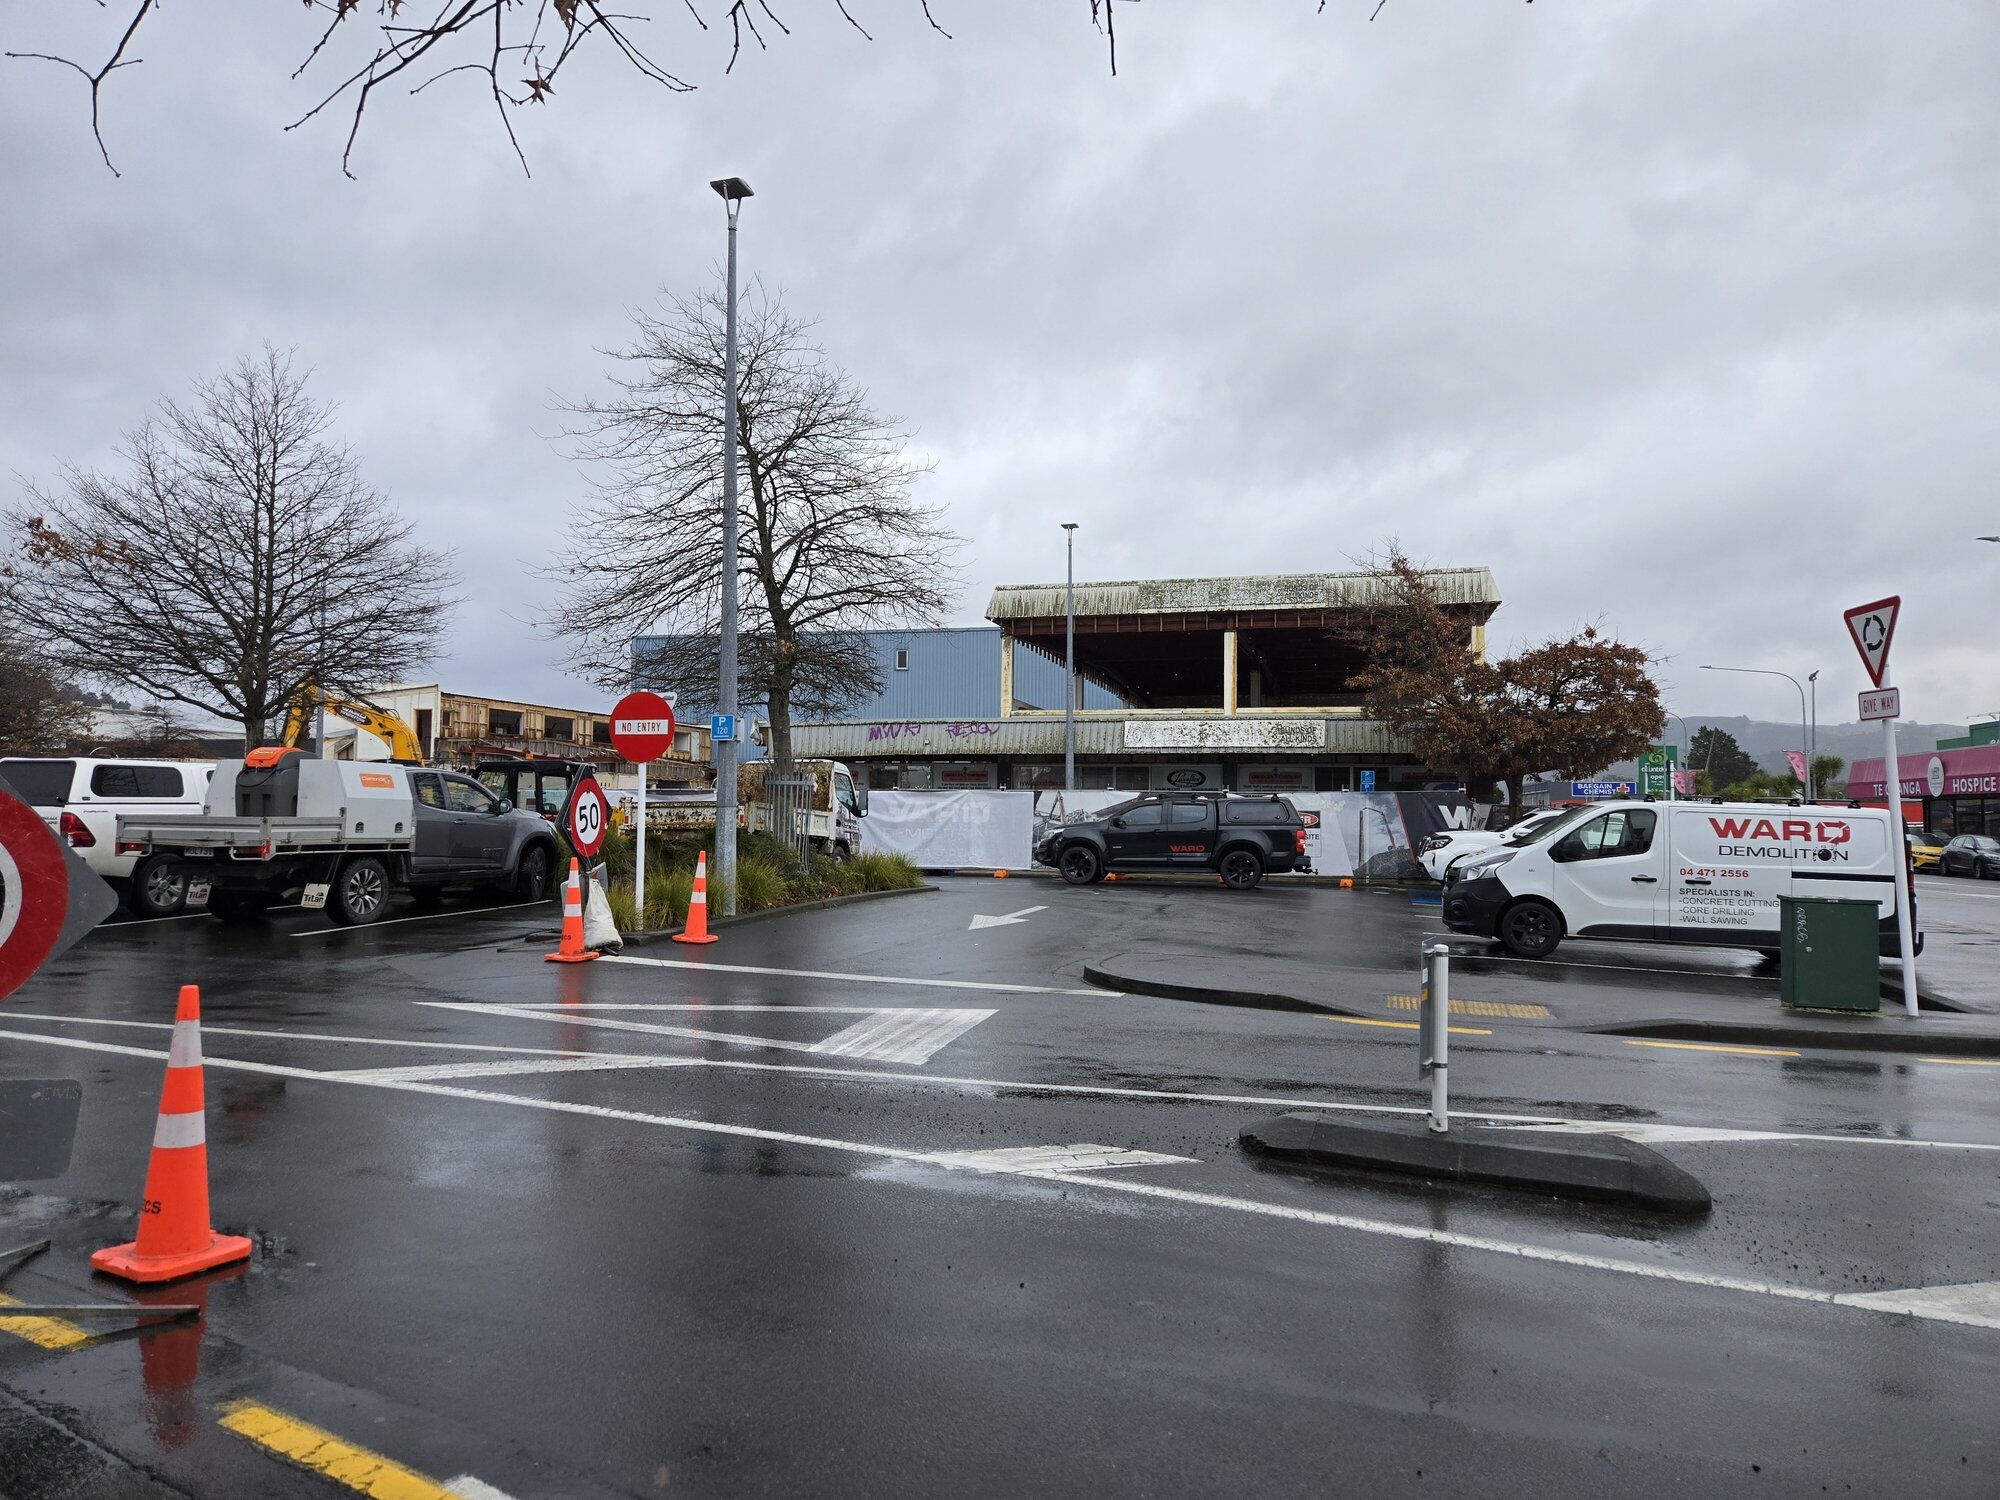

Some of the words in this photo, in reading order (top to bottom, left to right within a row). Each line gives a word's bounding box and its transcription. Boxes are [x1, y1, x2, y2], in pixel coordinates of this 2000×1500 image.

[1863, 699, 1877, 713] GIVE
[1880, 696, 1895, 711] WAY
[718, 716, 726, 726] P
[622, 722, 632, 732] NO
[638, 722, 661, 733] ENTRY
[717, 727, 728, 735] 120
[1952, 776, 1997, 793] HOSPICE
[1874, 784, 1883, 796] TE
[578, 802, 600, 834] 50
[1708, 817, 1851, 846] WARD
[1170, 845, 1206, 853] WARD
[1679, 868, 1694, 876] 04
[1696, 868, 1717, 877] 471
[1720, 869, 1750, 878] 2556
[188, 891, 208, 900] Titan
[1679, 887, 1742, 898] SPECIALISTS
[1743, 889, 1756, 898] IN:
[304, 894, 325, 903] Titan
[1737, 899, 1780, 908] CUTTING
[1712, 907, 1755, 917] DRILLING
[1710, 917, 1748, 926] SAWING
